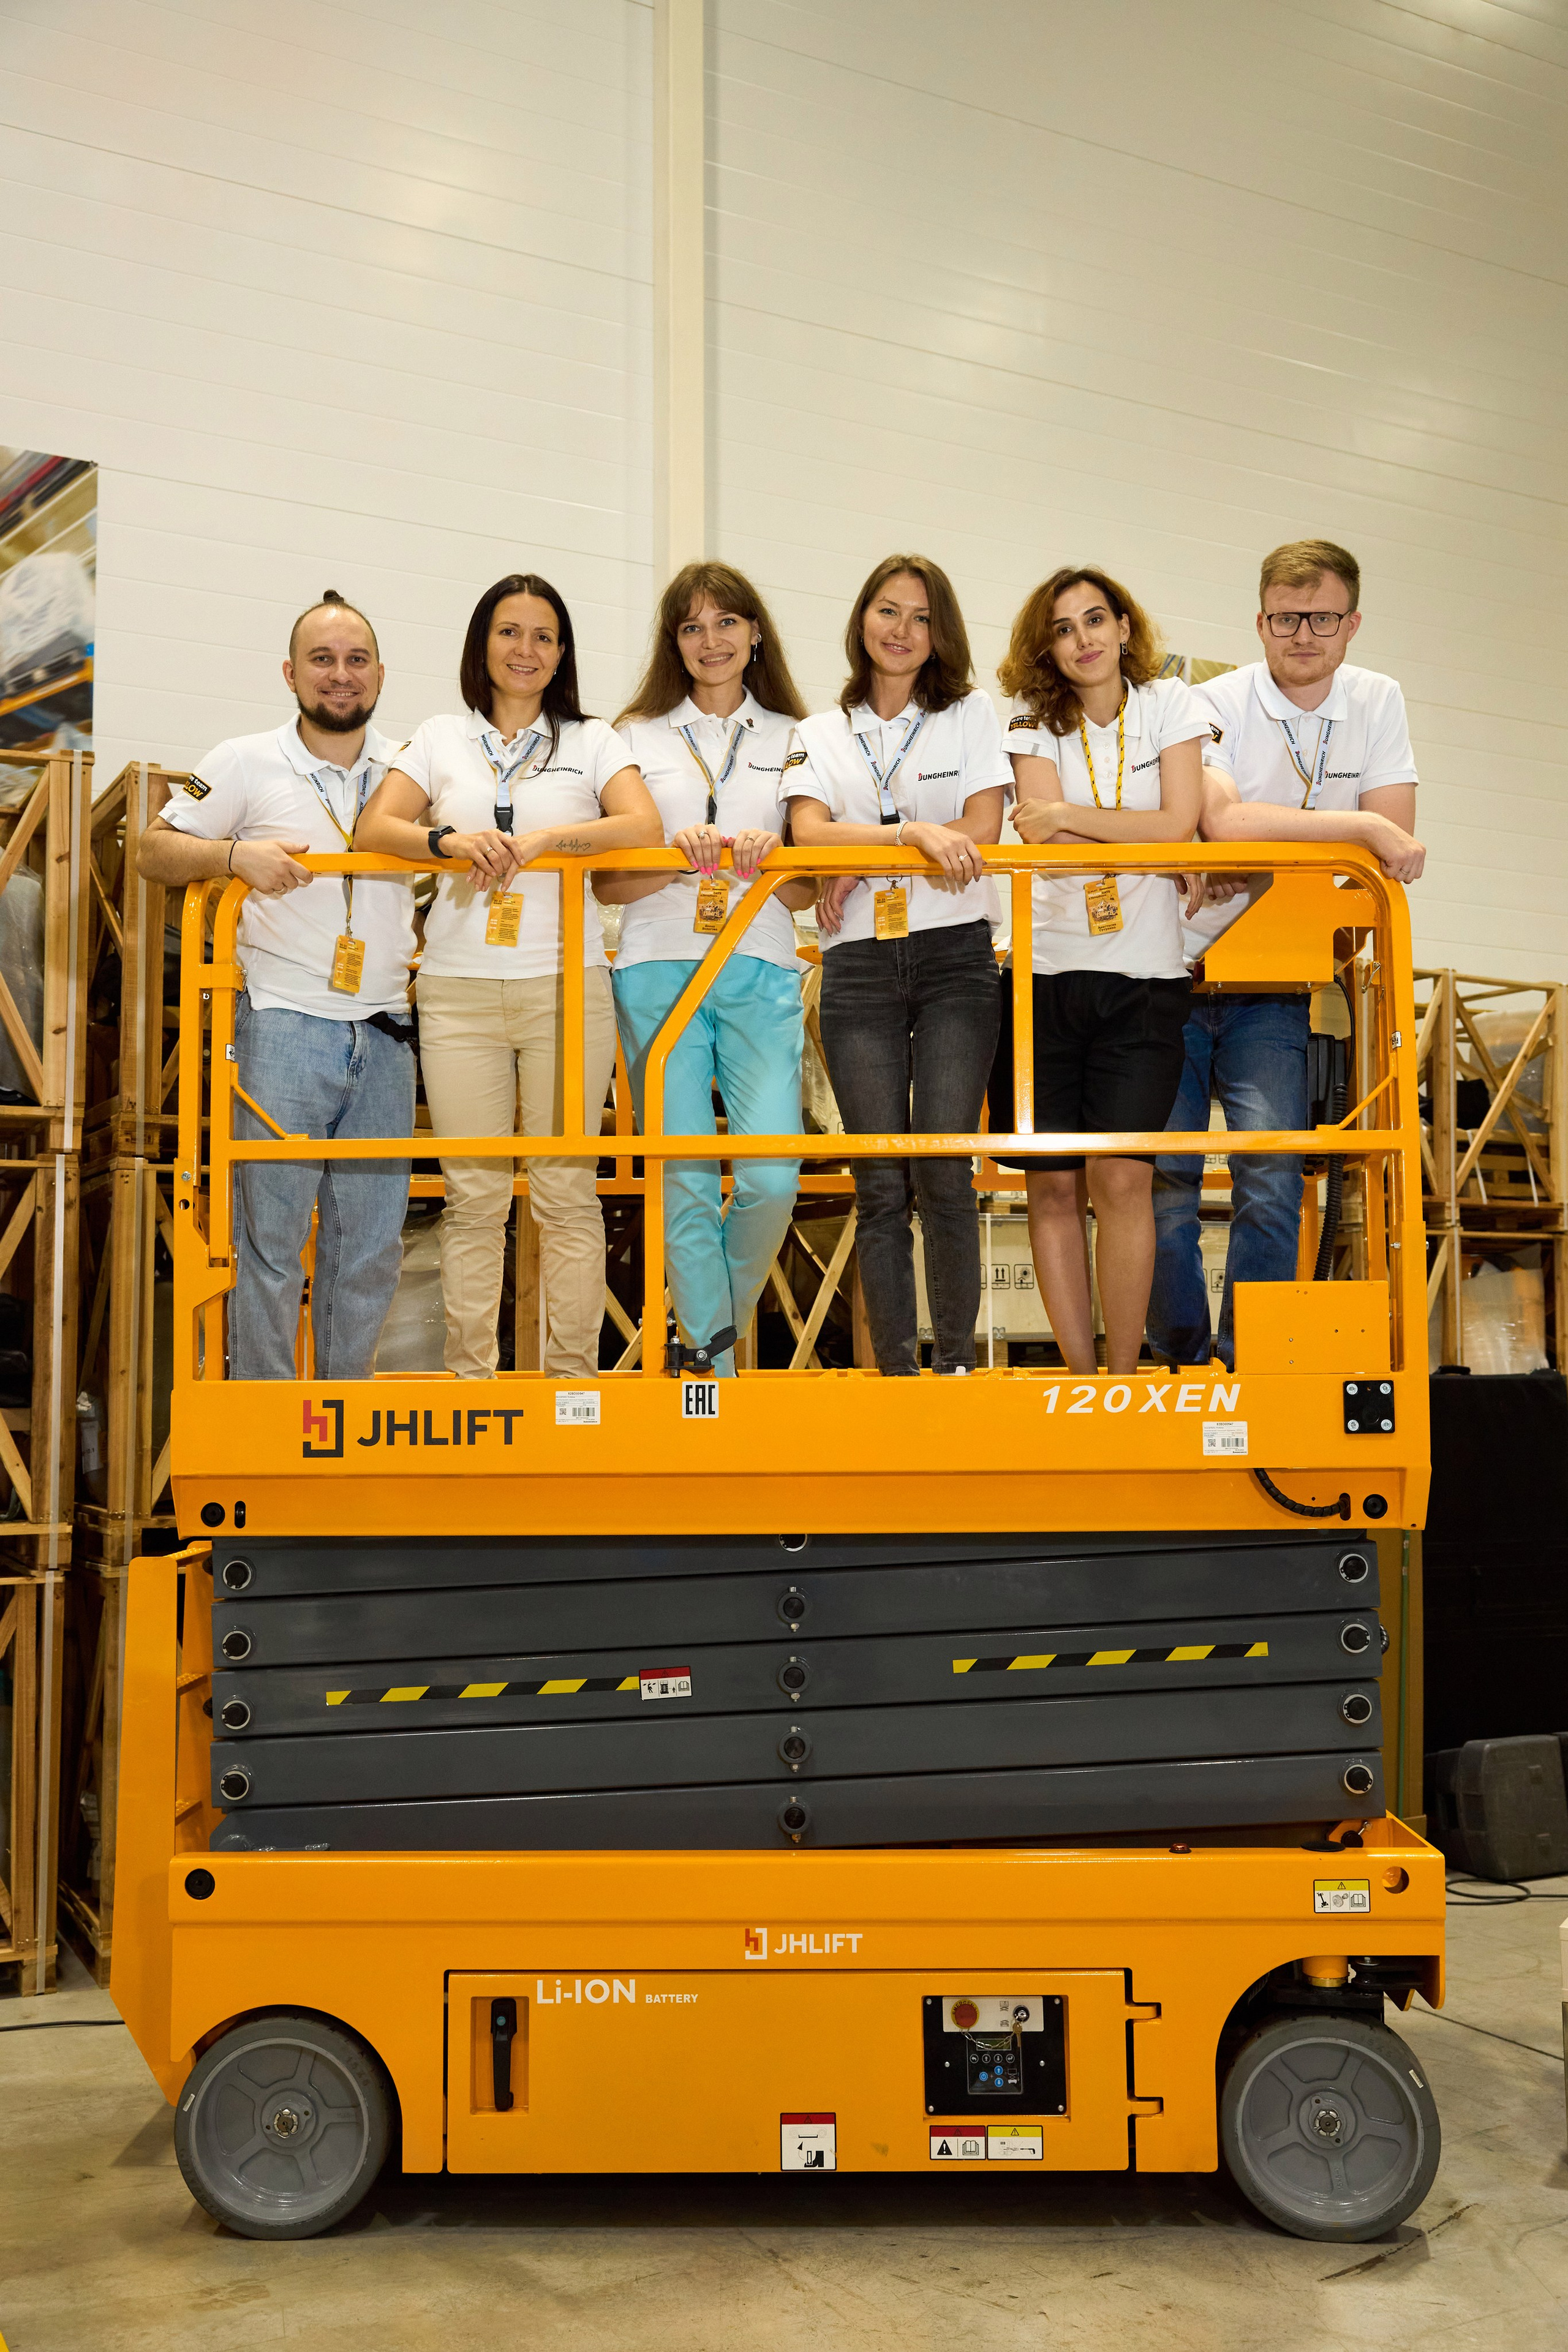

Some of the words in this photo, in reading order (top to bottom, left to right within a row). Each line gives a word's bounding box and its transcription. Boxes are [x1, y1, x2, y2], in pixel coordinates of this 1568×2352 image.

[481, 734, 494, 756] NGHEINRICH
[858, 733, 871, 756] NGHEINRICH
[900, 722, 921, 753] JUNGHEINRICH
[1281, 720, 1295, 745] GHEINRICH
[1323, 720, 1333, 745] JUNGHEIN
[522, 735, 541, 760] JUNGHEINRICH
[532, 765, 583, 775] JUNGHEINRICH
[719, 754, 734, 783] JUNGHEINRICH
[748, 762, 783, 772] JUNGHEIN
[883, 758, 902, 791] JUNGHEINRICH
[917, 770, 960, 781] JUNGHEINR
[1316, 750, 1326, 786] JUNGHEINRICH
[1325, 771, 1360, 779] JUNGHEINR
[194, 778, 208, 791] team
[309, 772, 325, 793] HEINRICH
[686, 1385, 717, 1415] EAC
[356, 1409, 524, 1447] JHLIFT
[774, 1934, 863, 1954] JHLIFT
[537, 1979, 636, 2004] Li-ION
[645, 1994, 699, 2004] BATTERY
